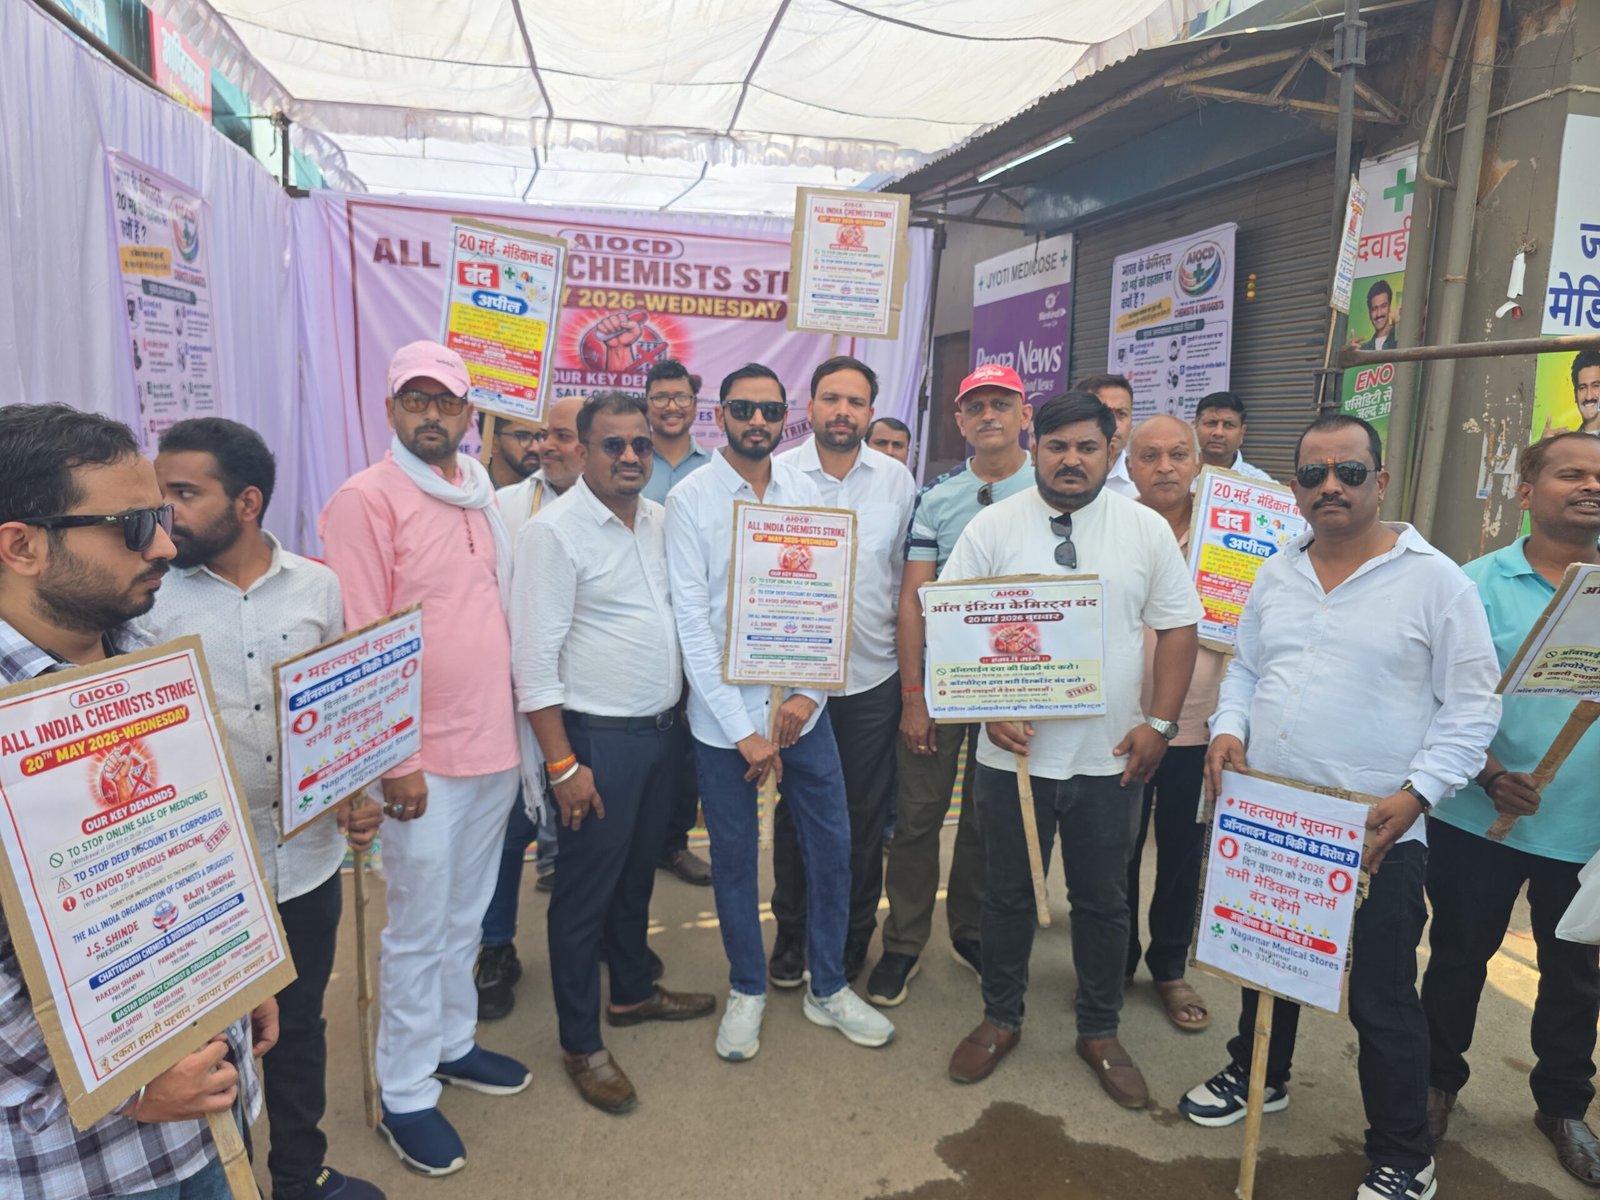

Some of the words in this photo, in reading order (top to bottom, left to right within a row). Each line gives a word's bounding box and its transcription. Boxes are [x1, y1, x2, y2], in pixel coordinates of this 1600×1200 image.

[458, 233, 475, 251] 20
[478, 235, 496, 256] मई
[502, 241, 538, 264] मेडिकल
[540, 250, 554, 267] बंद
[574, 234, 674, 254] AIOCD
[1358, 215, 1413, 261] दवाई
[373, 238, 440, 269] ALL
[566, 254, 732, 291] CHEMISTS
[1186, 246, 1215, 265] AIOCD
[462, 261, 493, 288] बंद
[986, 267, 1010, 289] JYOTI
[478, 289, 522, 316] अपील
[580, 290, 782, 319] 2026-WEDNESDAY
[1016, 340, 1062, 374] News
[586, 373, 618, 386] KEY
[1356, 363, 1394, 392] ENO
[1213, 481, 1230, 499] 20
[1233, 484, 1251, 504] मई
[1256, 492, 1290, 515] मेडिकल
[747, 521, 761, 529] ALL
[763, 522, 783, 531] INDIA
[786, 524, 821, 534] CHEMISTS
[822, 527, 845, 536] STRIKE
[1215, 506, 1243, 533] बंद
[1228, 533, 1270, 559] अपील
[931, 602, 960, 613] ऑल
[965, 600, 1004, 611] इंडिया
[1009, 597, 1072, 612] केमिस्ट्स
[1075, 596, 1097, 606] बंद
[308, 640, 368, 684] महत्वपूर्ण
[372, 626, 405, 656] सूचना
[75, 681, 125, 705] AIOCD
[295, 674, 343, 708] ऑनलाइन
[0, 728, 34, 756] ALL
[34, 712, 84, 743] INDIA
[83, 690, 155, 728] CHEMISTS
[153, 677, 196, 705] STRIKE
[54, 741, 87, 763] MAY
[86, 706, 188, 752] 2026-WEDNESDAY
[305, 722, 331, 748] सभी
[67, 845, 80, 858] TO
[81, 834, 105, 852] STOP
[105, 821, 136, 841] ONLINE
[136, 812, 156, 828] SALE
[156, 806, 168, 818] OF
[169, 789, 208, 813] MEDICINES
[84, 815, 108, 832] OUR
[109, 805, 129, 822] KEY
[129, 787, 174, 813] DEMANDS
[1237, 797, 1297, 831] महत्वपूर्ण
[1299, 816, 1343, 843] सूचना
[74, 869, 87, 882] TO
[87, 859, 110, 876] STOP
[110, 849, 131, 865] DEEP
[130, 832, 168, 856] DISCOUNT
[168, 827, 179, 838] BY
[179, 806, 223, 833] CORPORATES
[203, 823, 233, 851] STRIKE
[1222, 816, 1266, 840] ऑनलाइन
[1266, 831, 1283, 845] दवा
[1308, 841, 1319, 855] के
[1319, 844, 1345, 862] विरोध
[1346, 850, 1355, 864] में
[80, 886, 94, 901] TO
[94, 872, 124, 894] AVOID
[125, 851, 167, 878] SPURIOUS
[166, 832, 205, 858] MEDICINE
[1242, 856, 1256, 868] दिन
[1258, 861, 1283, 877] बुधवार
[1285, 869, 1296, 880] को
[1297, 873, 1310, 884] देश
[1312, 877, 1323, 888] की
[1243, 842, 1268, 858] दिनांक
[1270, 852, 1283, 862] 20
[1285, 853, 1299, 868] मई
[1300, 860, 1325, 874] 2026
[182, 885, 205, 903] RAJIV
[205, 868, 235, 890] SINGHAL
[1224, 863, 1249, 883] सभी
[1253, 873, 1299, 899] मेडिकल
[1303, 888, 1337, 911] स्टोर्स
[1248, 888, 1266, 905] बंद
[1270, 895, 1300, 917] रहेंगी
[72, 929, 87, 944] THE
[86, 922, 100, 936] ALL
[100, 911, 120, 929] INDIA
[120, 888, 166, 918] ORGANISATION
[165, 883, 174, 895] OF
[174, 869, 201, 890] CHEMISTS
[85, 940, 105, 957] J.S.
[105, 920, 139, 946] SHINDE
[95, 936, 133, 961] PRESIDENT
[97, 952, 141, 983] CHATTISGARH
[142, 938, 165, 958] CHEMIST
[165, 935, 171, 944] &
[170, 915, 205, 940] DISTRIBUTOR
[1230, 926, 1269, 949] Nagarnar
[1272, 941, 1306, 961] Medical
[1309, 953, 1339, 971] Stores
[1241, 947, 1252, 956] Ph
[95, 983, 121, 1003] RAKESH
[120, 968, 145, 987] SHARMA
[115, 1000, 138, 1019] BASTAR
[137, 985, 163, 1005] DISTRICT
[163, 970, 186, 989] CHEMIST
[96, 1023, 125, 1046] PRASHANT
[111, 1041, 137, 1063] एकता
[137, 1021, 162, 1045] हमारी
[163, 1005, 191, 1029] पहचान
